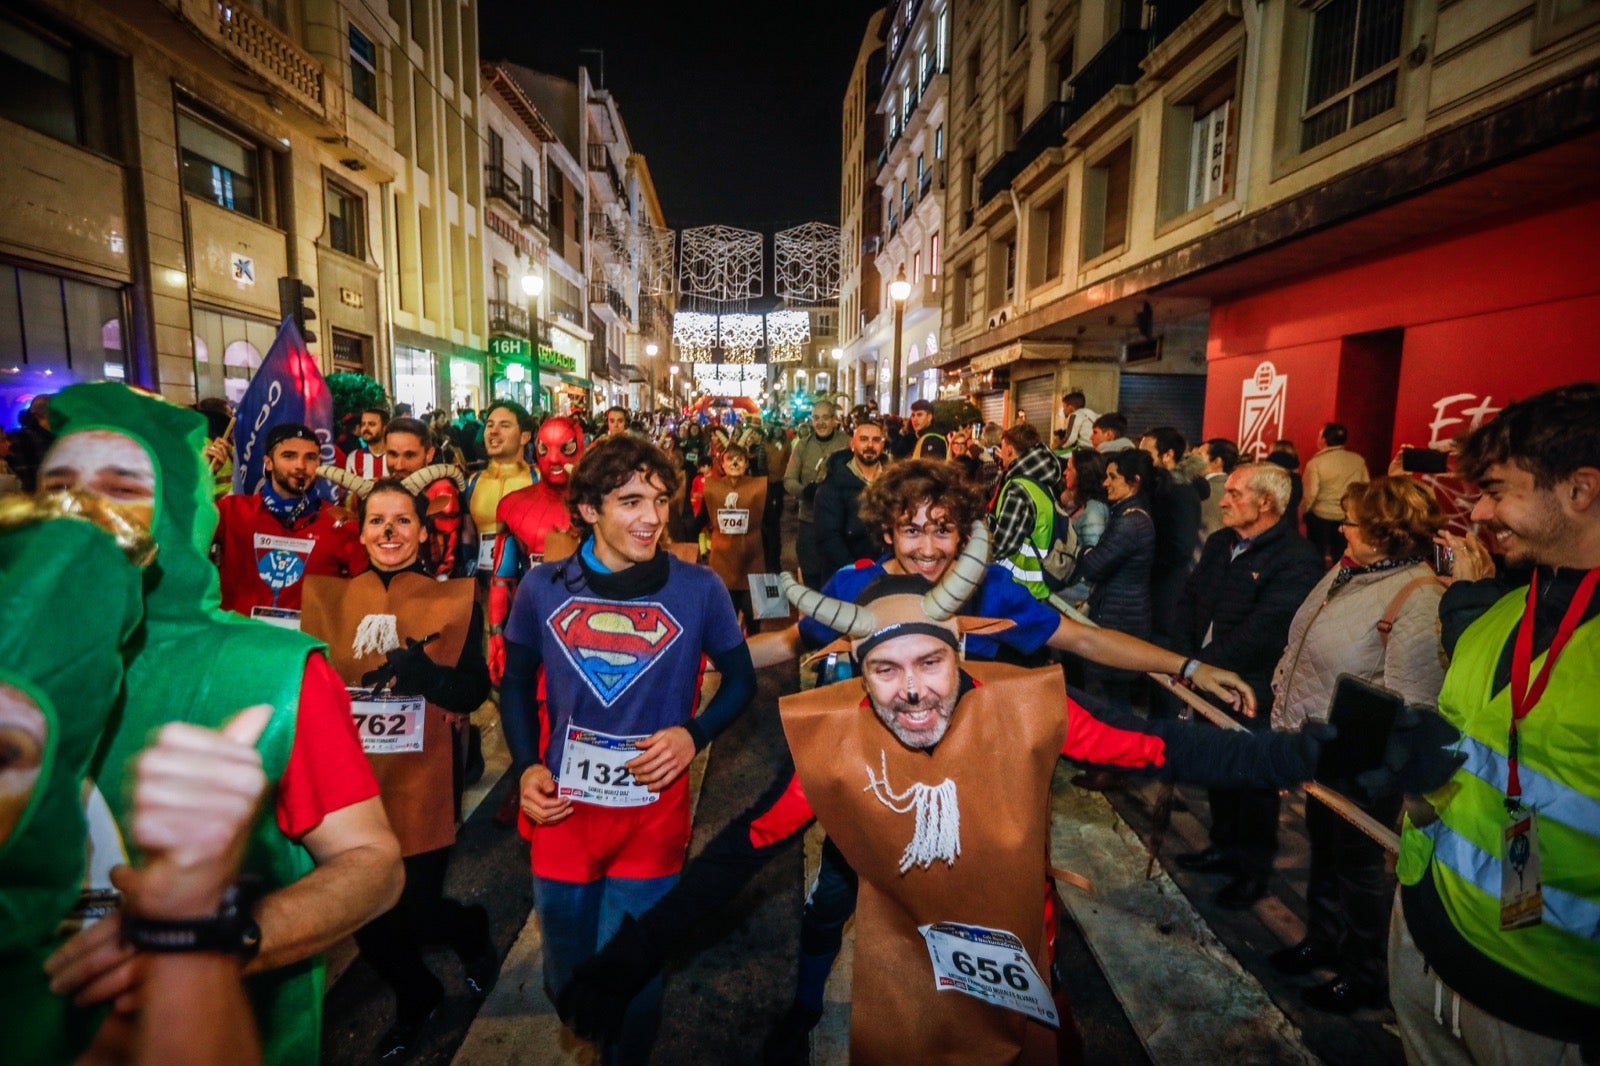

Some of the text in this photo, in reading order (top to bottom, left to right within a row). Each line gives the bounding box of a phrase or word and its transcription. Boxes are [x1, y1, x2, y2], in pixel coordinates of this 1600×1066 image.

[492, 340, 520, 354] 16H
[723, 518, 743, 528] 704
[352, 713, 406, 736] 762
[577, 759, 643, 787] 132
[952, 950, 1029, 991] 656
